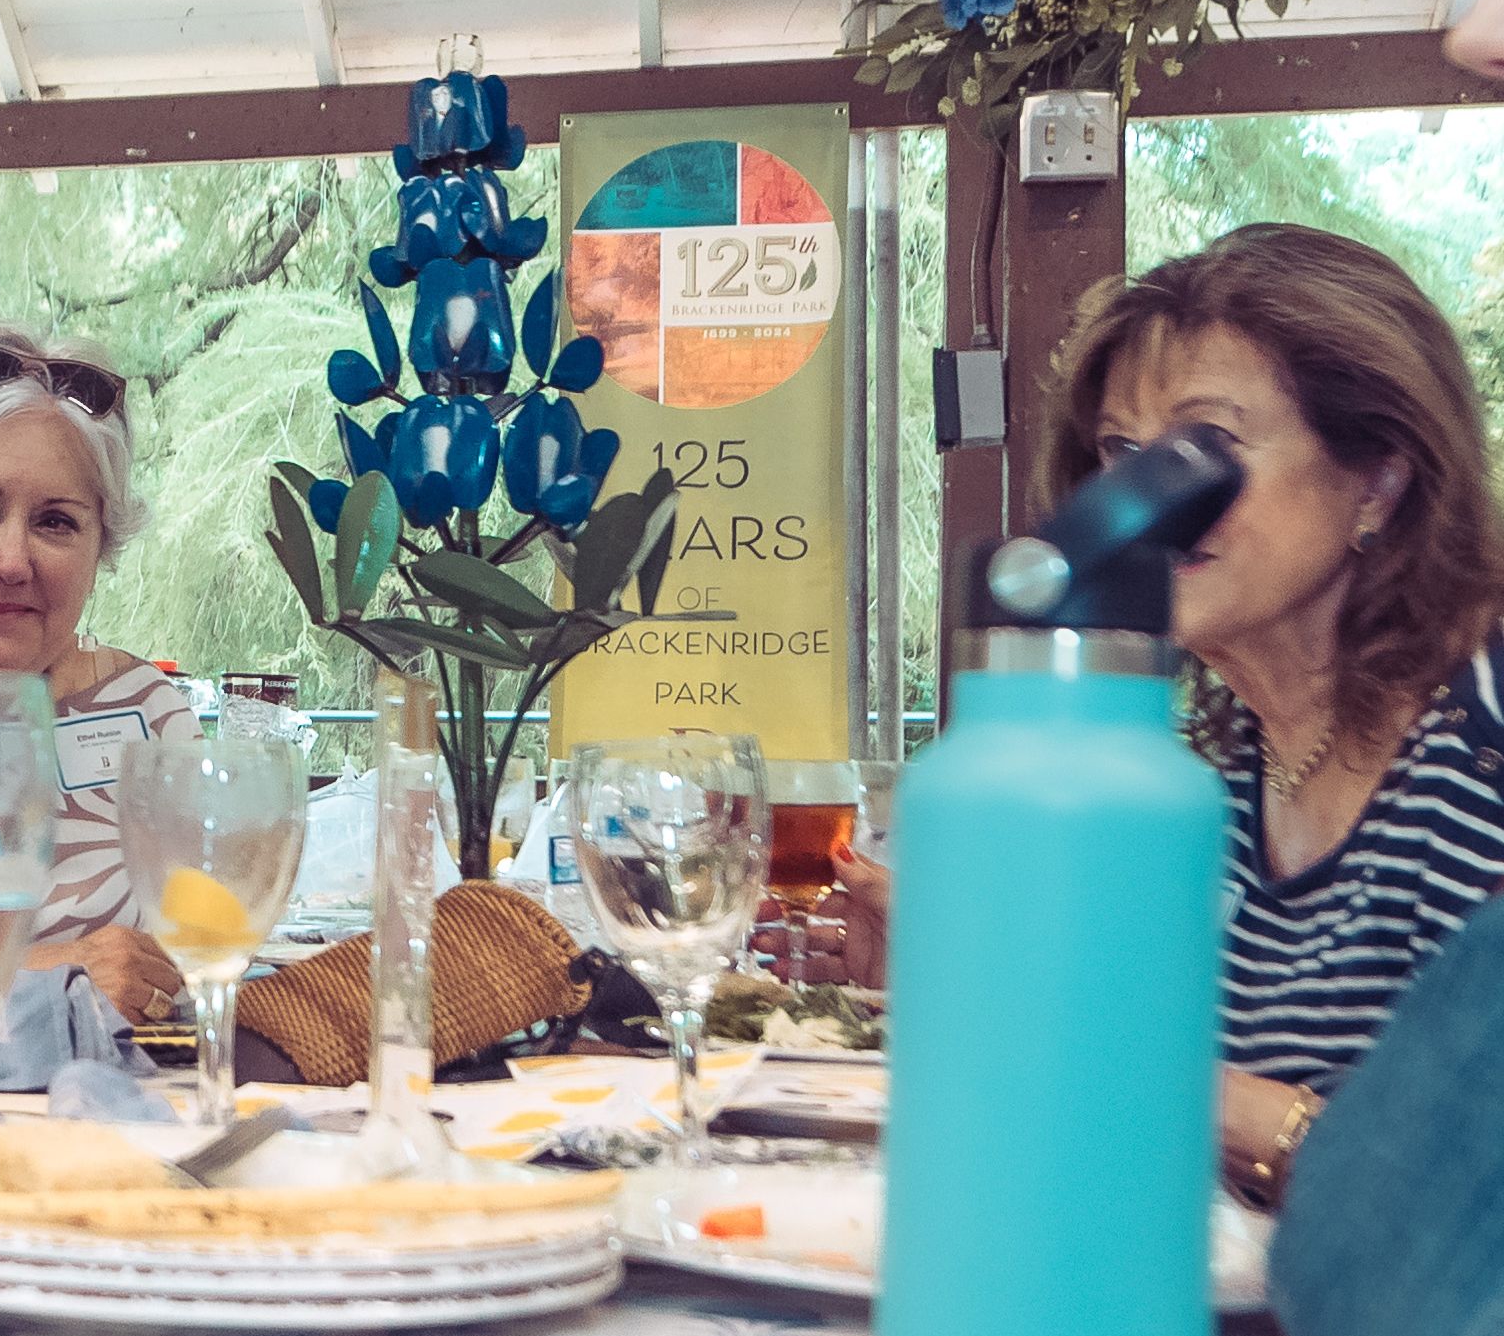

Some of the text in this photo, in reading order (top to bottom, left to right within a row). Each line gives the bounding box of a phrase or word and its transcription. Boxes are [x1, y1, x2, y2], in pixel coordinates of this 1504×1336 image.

[672, 300, 827, 316] BRACKENRIDGE PARK
[653, 439, 750, 489] 125
[669, 515, 809, 561] ARS
[676, 586, 722, 611] OF
[585, 629, 831, 656] RACKENRIDGE
[654, 681, 742, 705] PARK
